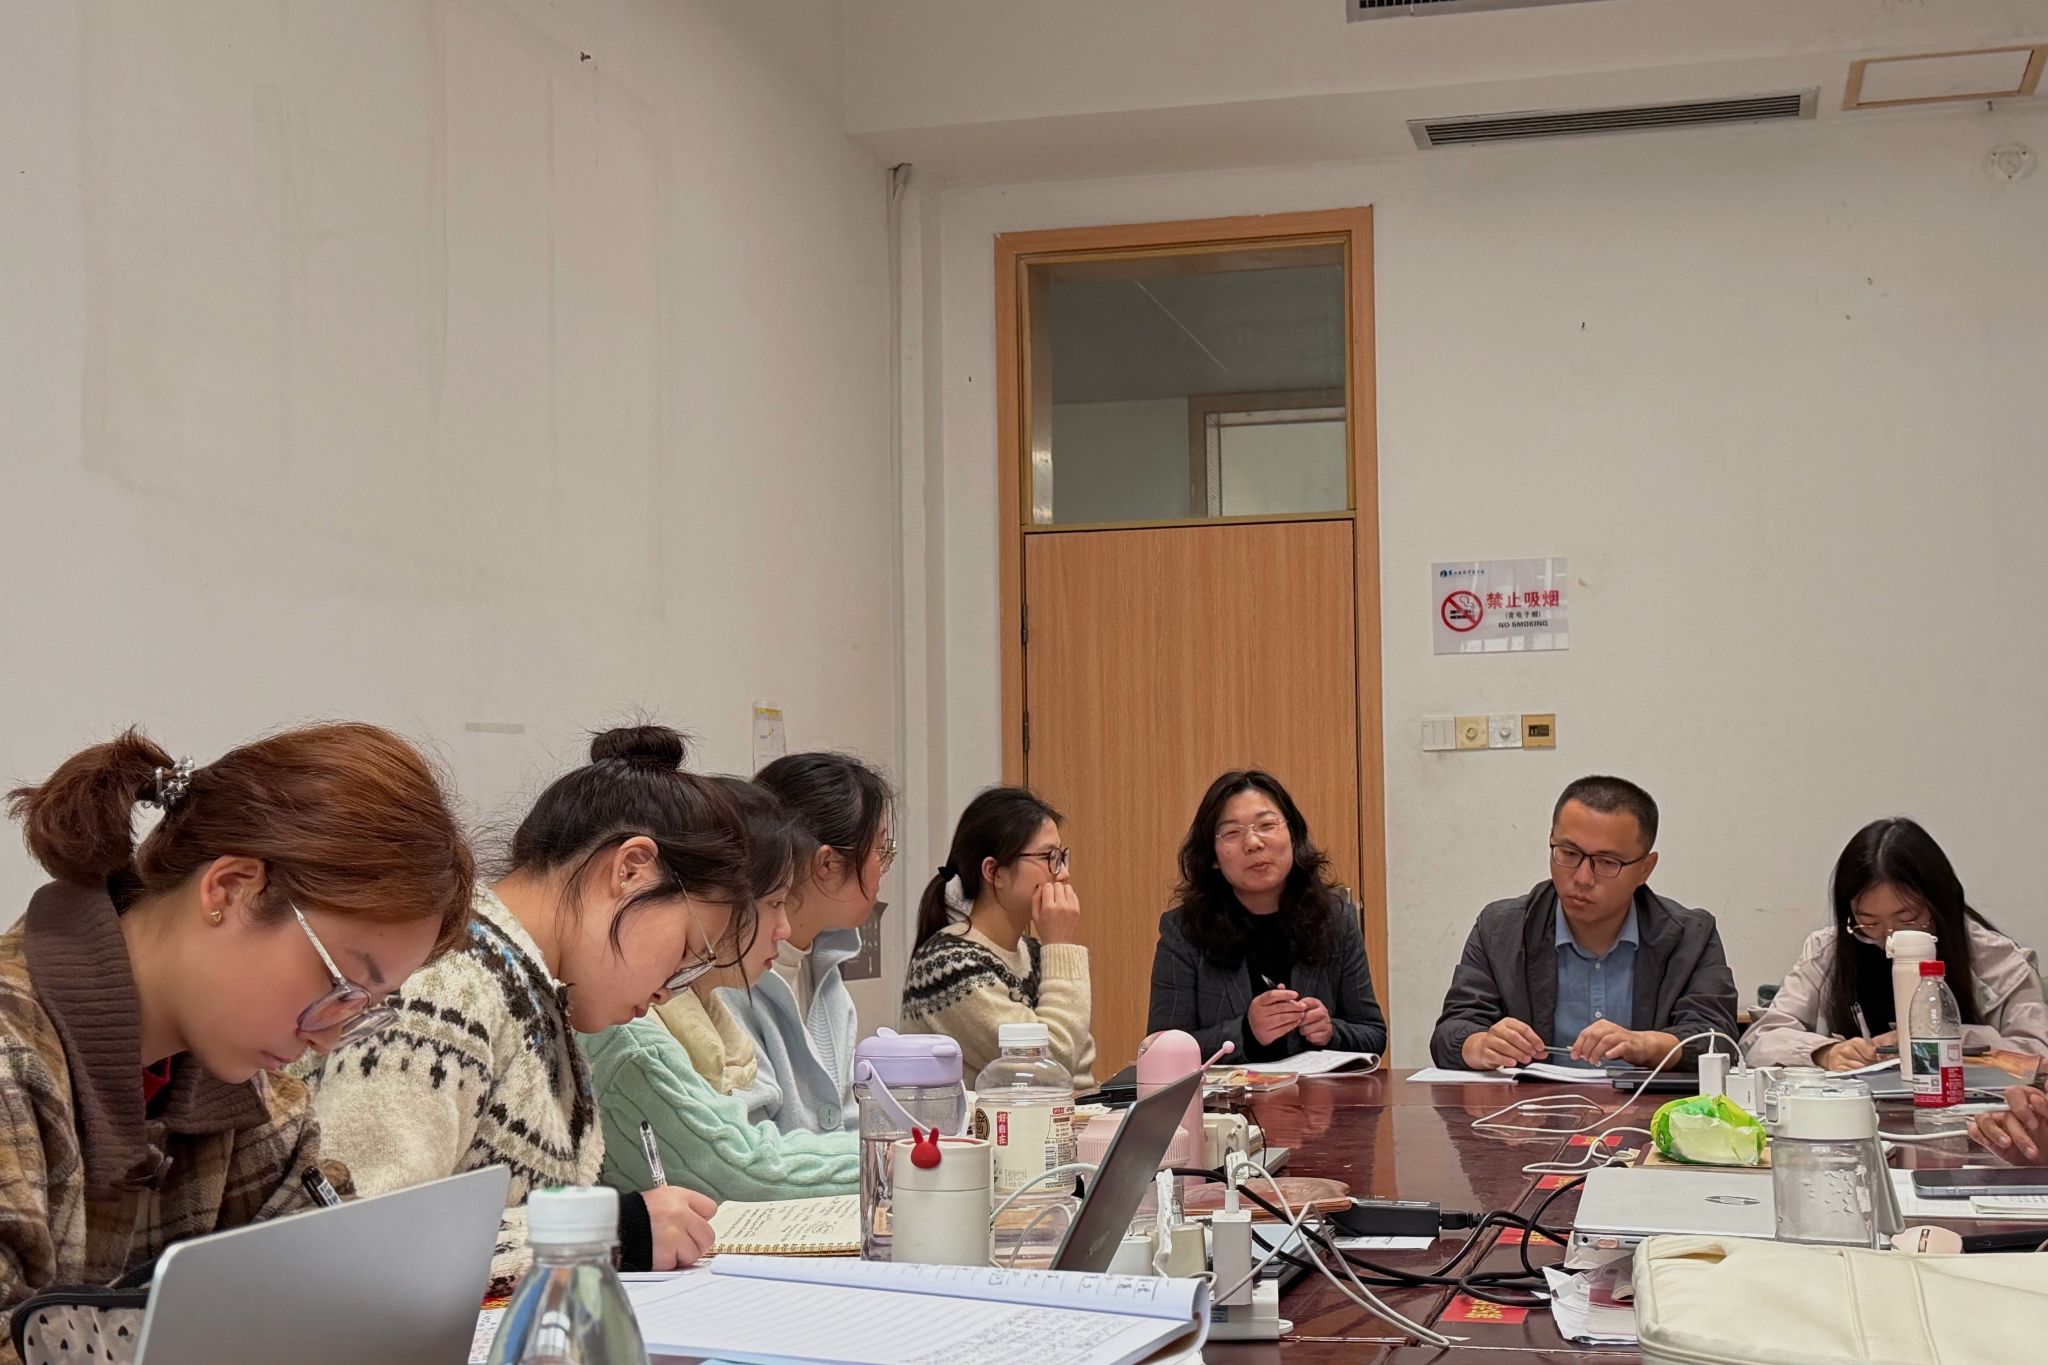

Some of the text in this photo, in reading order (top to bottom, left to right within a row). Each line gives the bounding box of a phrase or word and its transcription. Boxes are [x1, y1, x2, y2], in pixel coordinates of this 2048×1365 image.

[1487, 590, 1560, 609] 禁止吸烟
[1511, 620, 1548, 628] SMOKING
[998, 1113, 1007, 1145] 好自在
